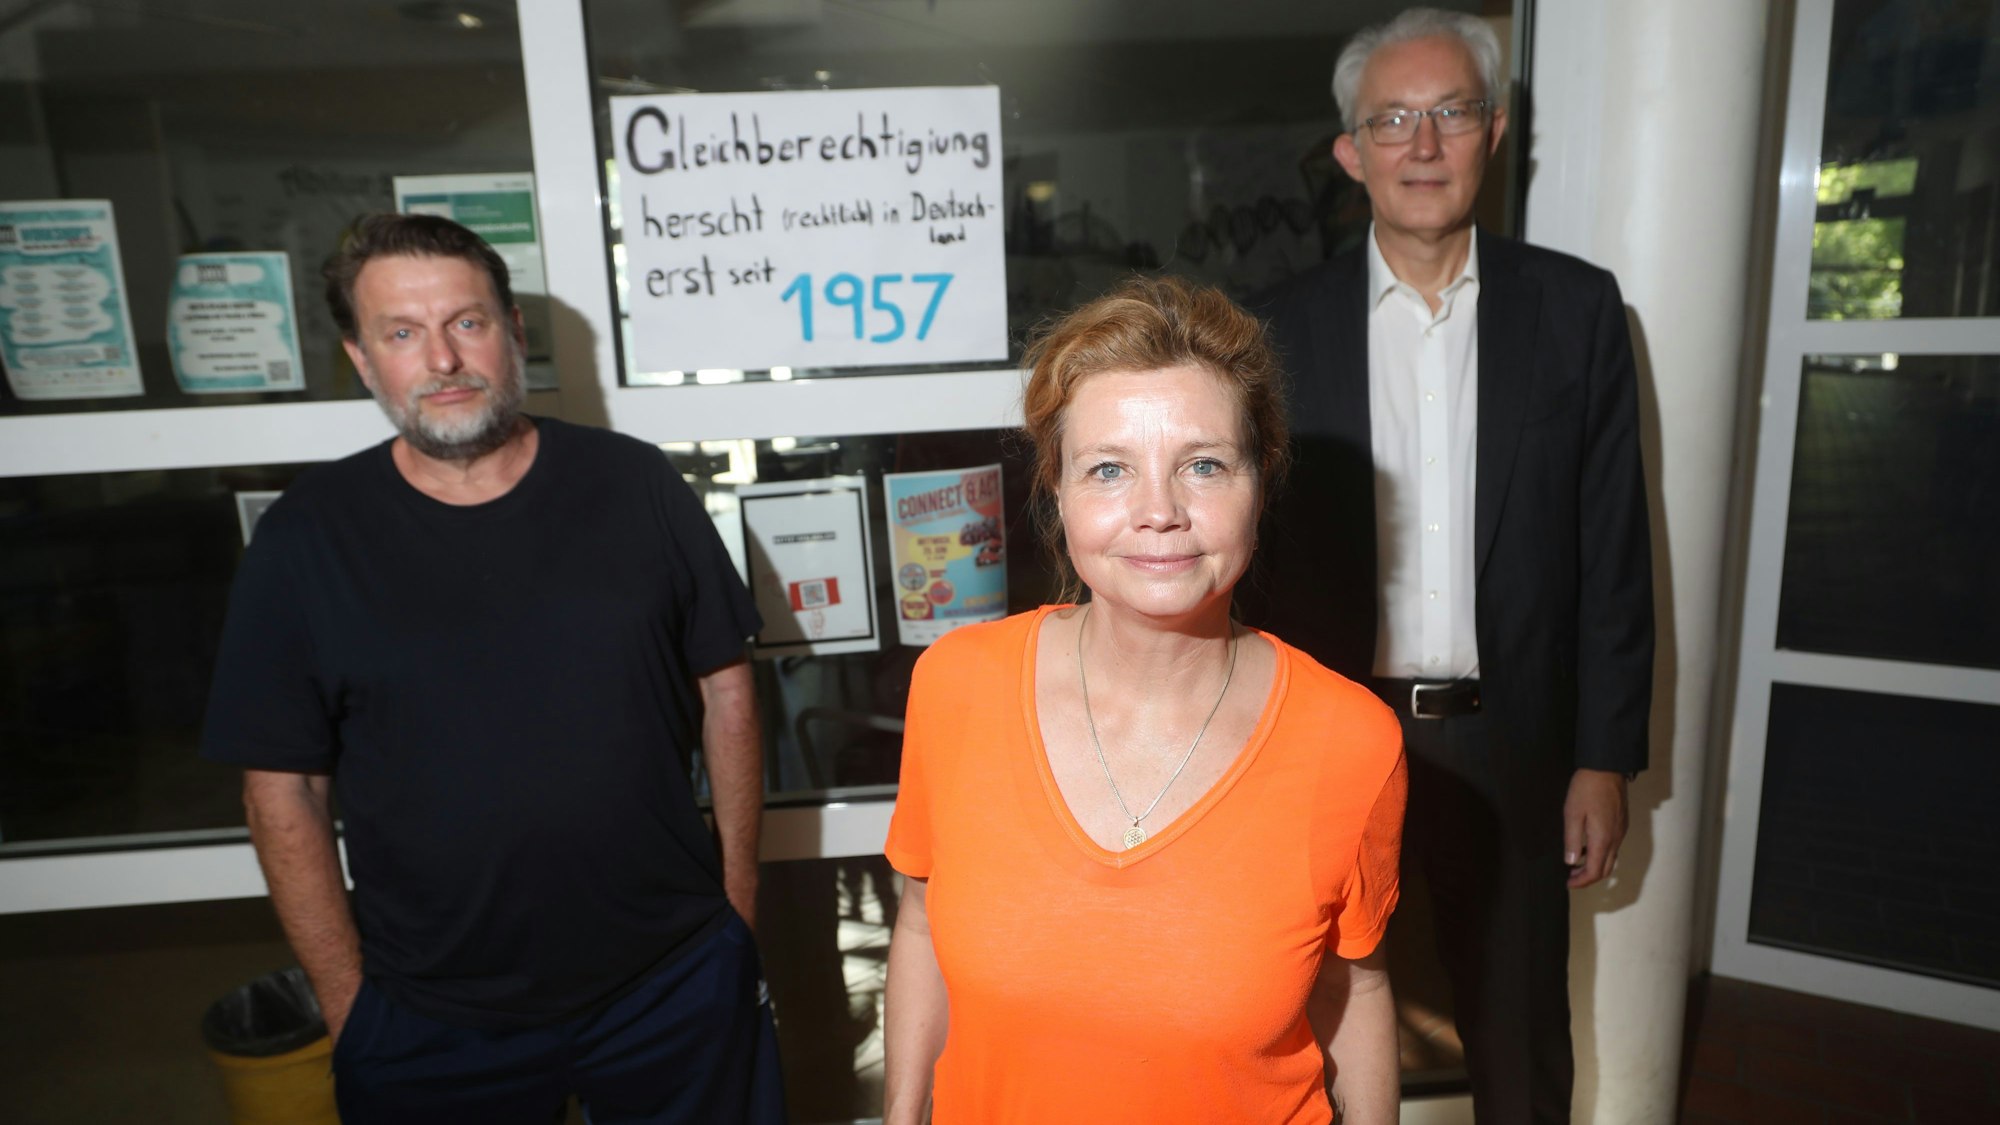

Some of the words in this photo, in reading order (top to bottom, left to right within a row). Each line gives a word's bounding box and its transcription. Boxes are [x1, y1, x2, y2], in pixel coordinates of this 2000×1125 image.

[641, 194, 765, 239] herscht
[883, 201, 899, 223] in
[929, 224, 966, 244] land
[645, 255, 715, 298] erst
[728, 256, 776, 286] seit
[780, 271, 955, 344] 1957
[898, 484, 962, 520] CONNECT
